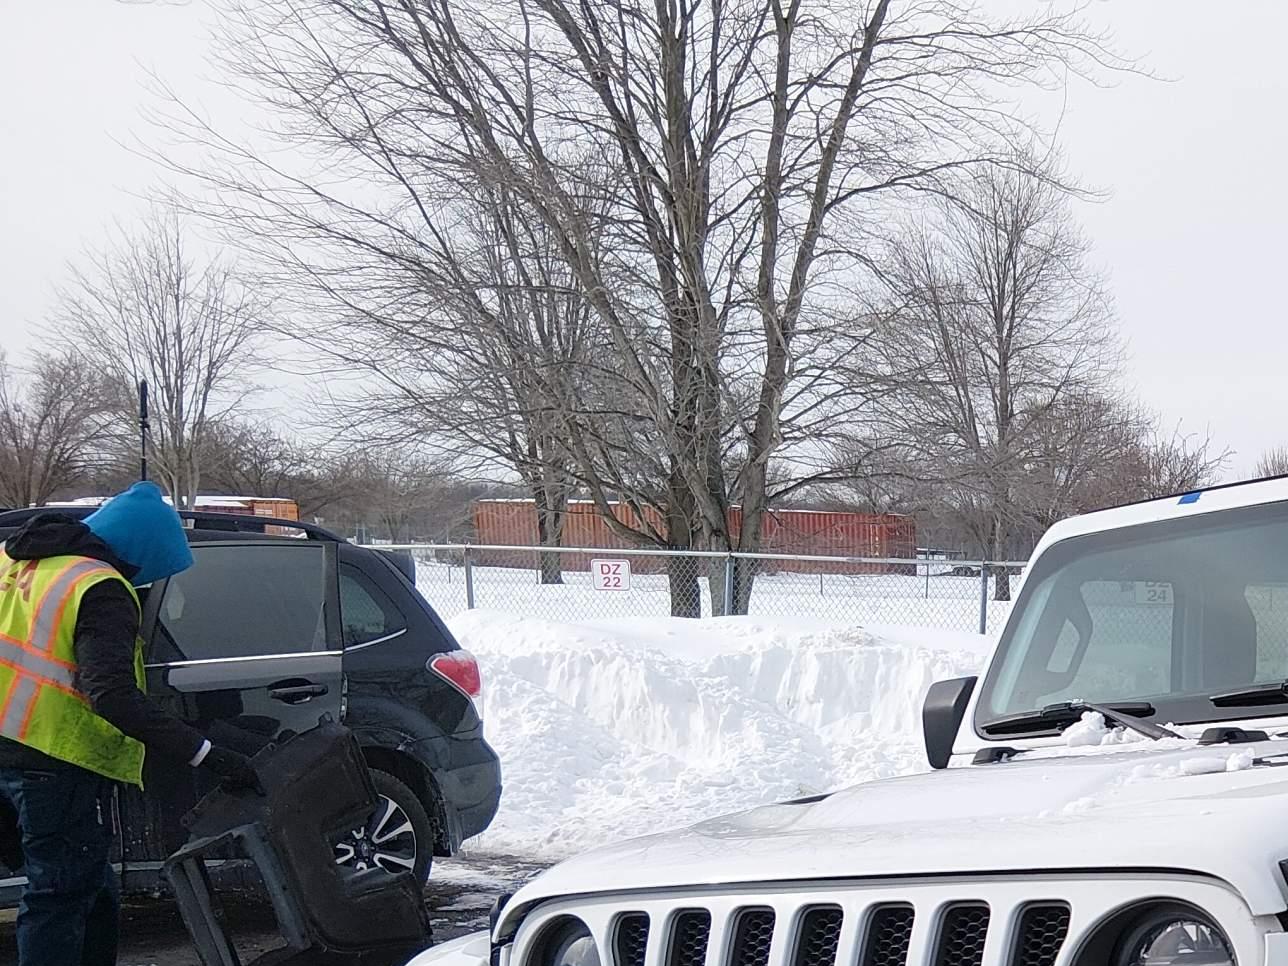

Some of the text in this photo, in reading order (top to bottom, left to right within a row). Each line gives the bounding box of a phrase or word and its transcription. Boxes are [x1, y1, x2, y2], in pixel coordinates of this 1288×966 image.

[600, 563, 621, 575] DZ
[603, 577, 621, 588] 22
[1147, 589, 1167, 602] 24
